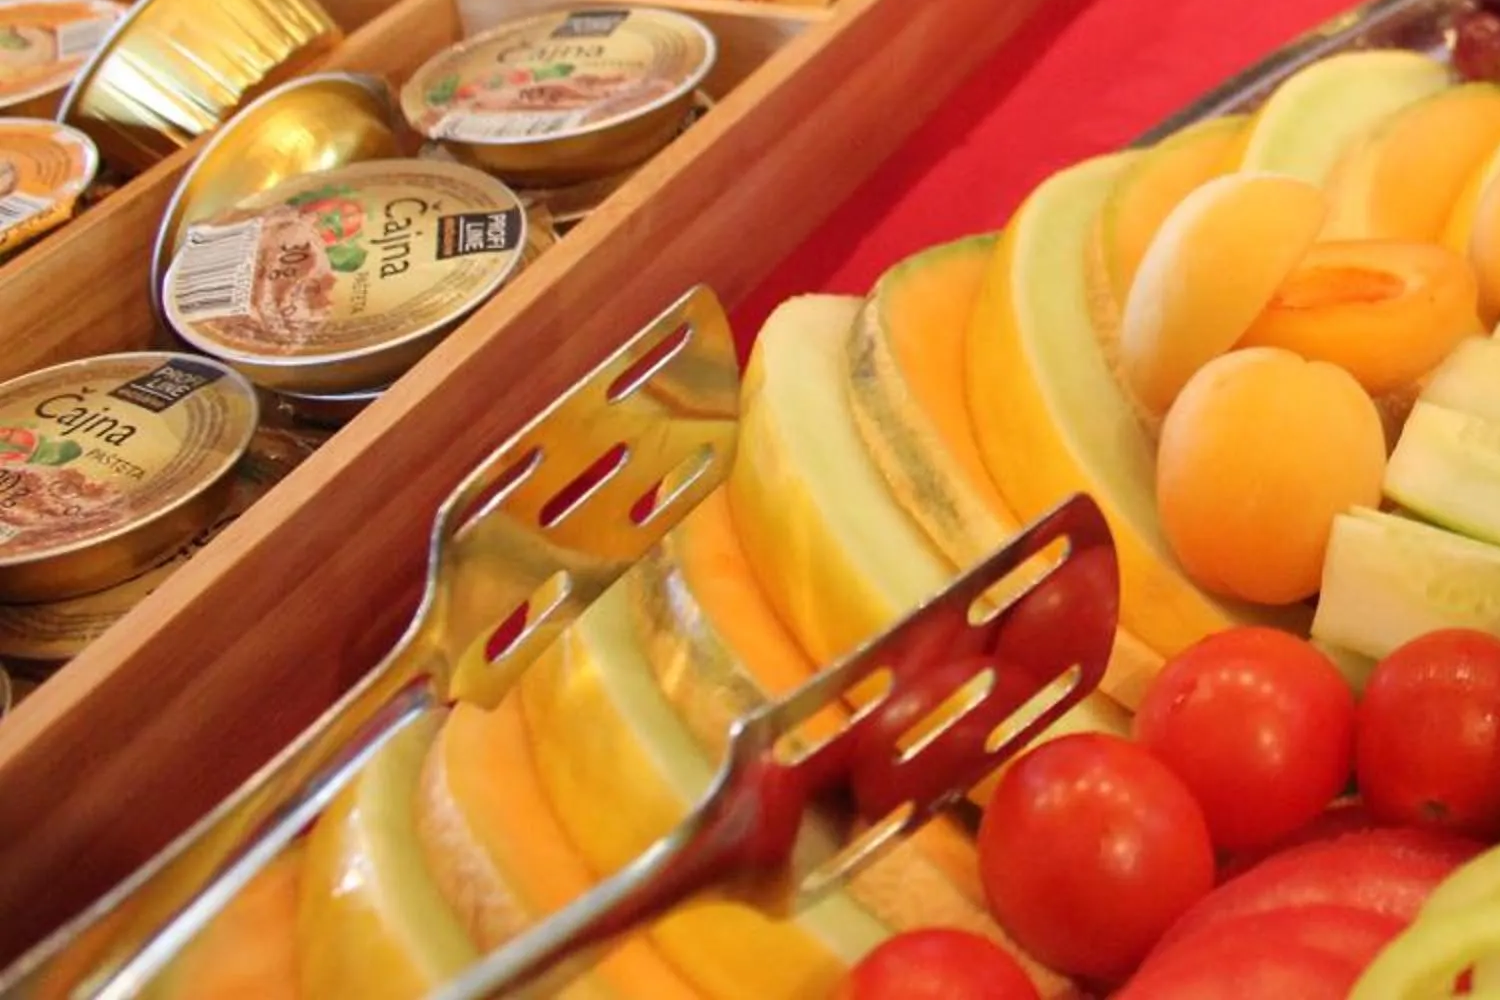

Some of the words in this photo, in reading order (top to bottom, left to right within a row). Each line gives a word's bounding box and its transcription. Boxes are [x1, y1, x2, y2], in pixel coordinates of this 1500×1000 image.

[369, 197, 441, 280] Čajna
[463, 217, 484, 253] LINE
[486, 213, 507, 251] PROFI
[146, 380, 190, 398] LINE
[34, 386, 137, 447] Čajna
[85, 448, 146, 481] PAŠTETA
